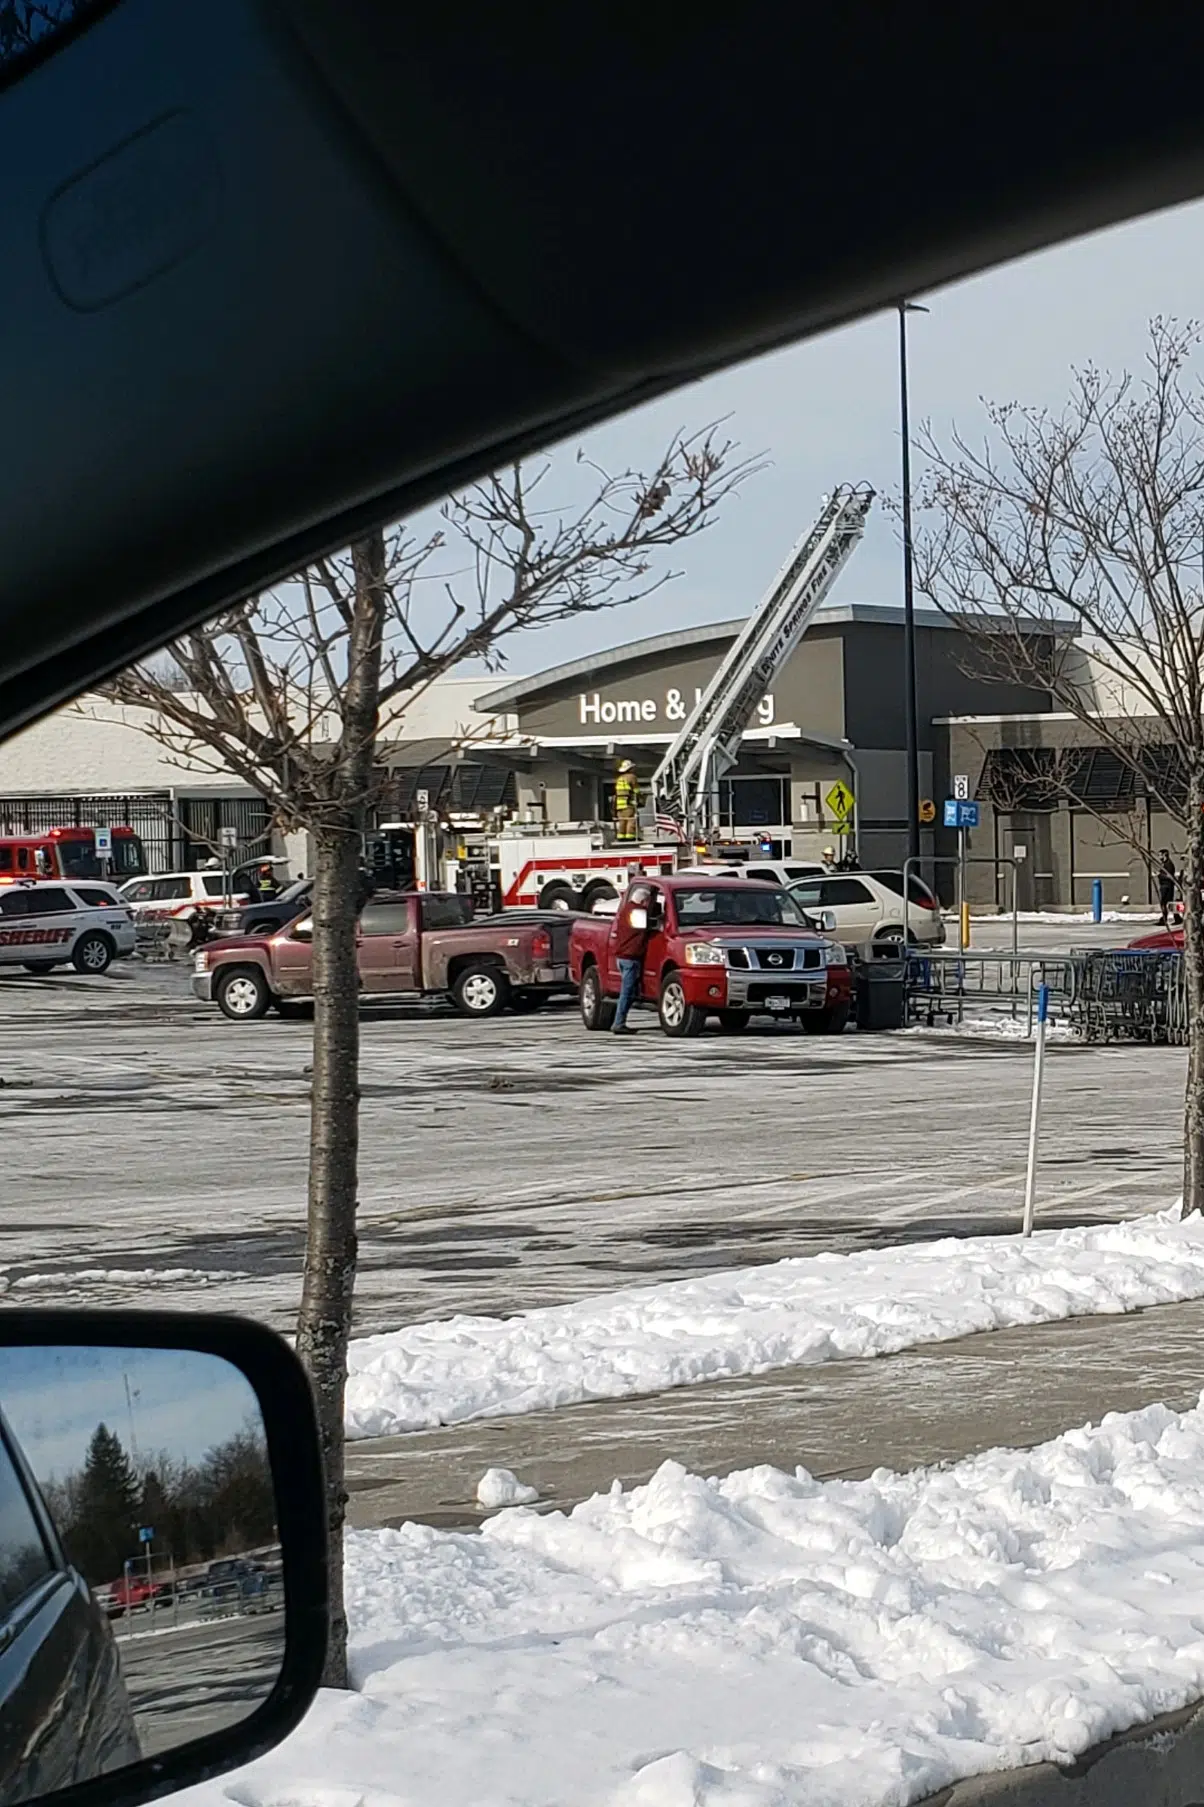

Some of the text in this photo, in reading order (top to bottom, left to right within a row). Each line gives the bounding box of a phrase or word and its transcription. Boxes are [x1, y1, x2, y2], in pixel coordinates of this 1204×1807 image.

[783, 591, 812, 639] SPRINGS
[810, 564, 828, 594] FIRE
[580, 693, 657, 724] Home
[665, 688, 687, 720] &
[957, 782, 966, 798] 8
[0, 927, 73, 947] SHERIFF
